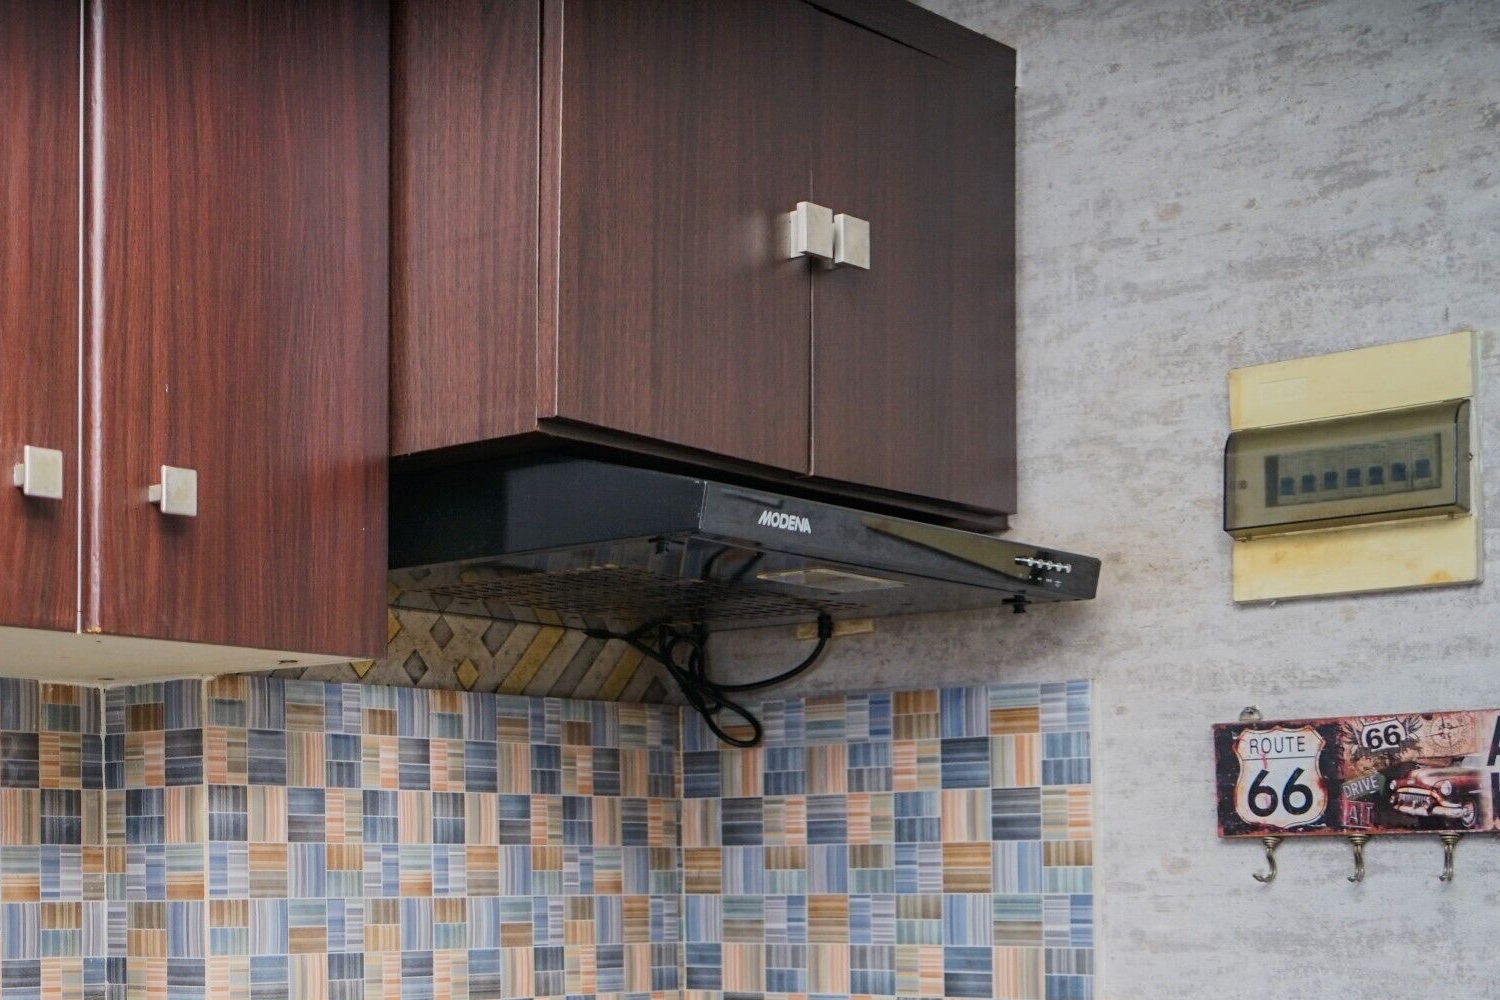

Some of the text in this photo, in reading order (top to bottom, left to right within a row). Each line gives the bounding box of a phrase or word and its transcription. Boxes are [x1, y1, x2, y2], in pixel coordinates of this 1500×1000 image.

[757, 509, 812, 534] MODENA
[1249, 735, 1306, 755] ROUTE
[1365, 724, 1402, 750] 66
[1247, 766, 1314, 818] 66
[1343, 775, 1380, 798] DRIVE
